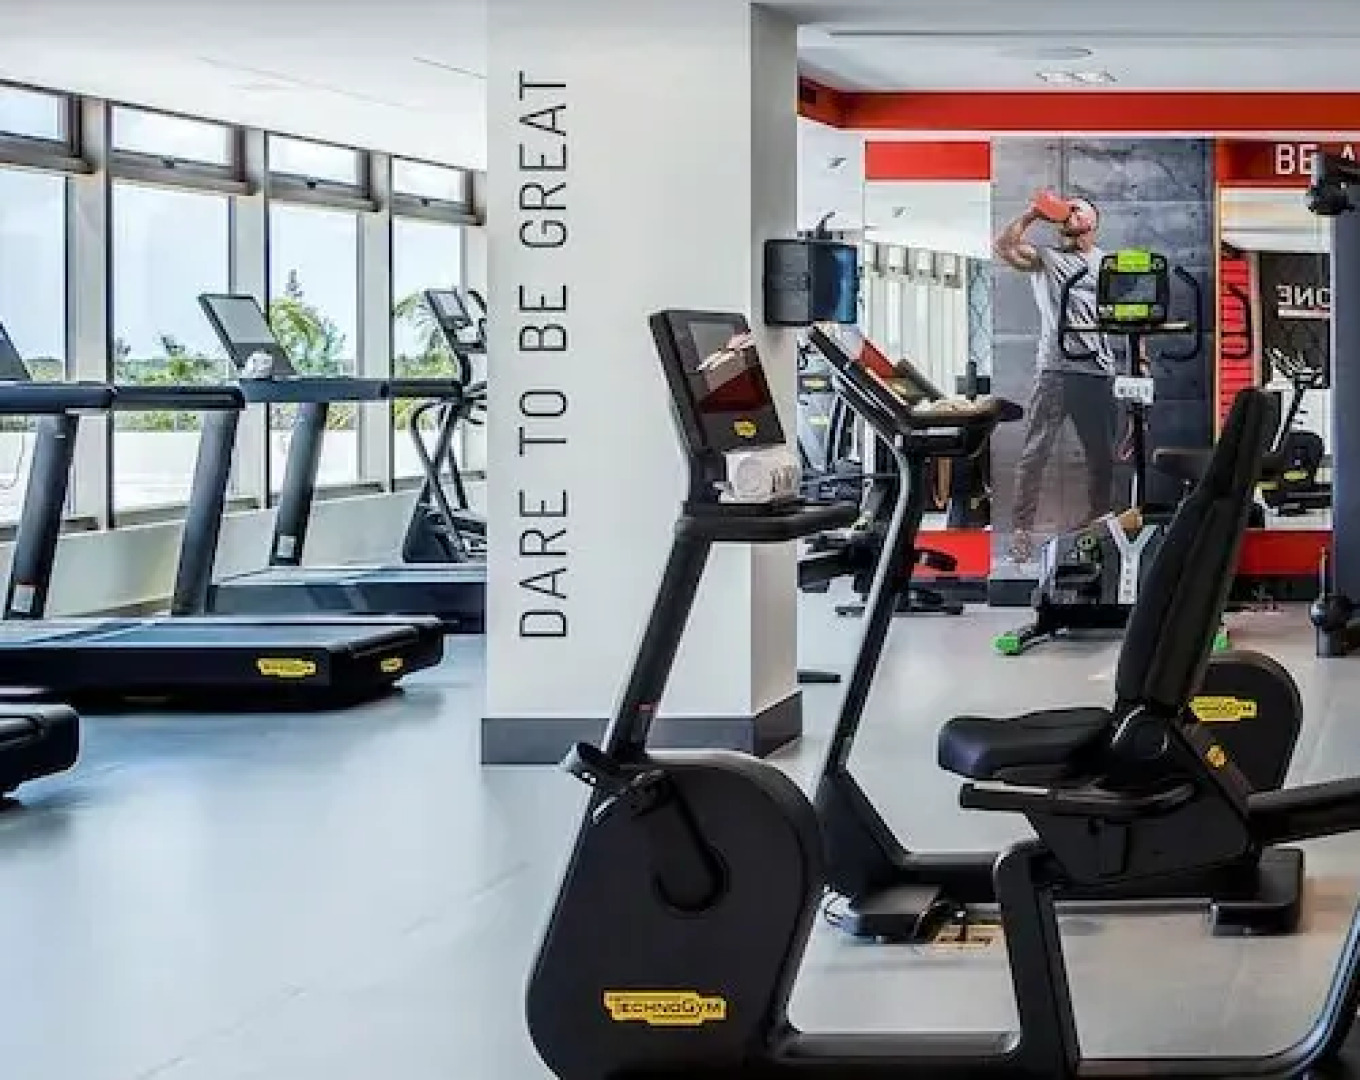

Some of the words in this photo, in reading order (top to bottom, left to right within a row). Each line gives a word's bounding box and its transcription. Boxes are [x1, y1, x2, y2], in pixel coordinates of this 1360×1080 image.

[518, 70, 567, 247] GREAT
[1275, 143, 1318, 175] BE
[518, 285, 567, 351] BE
[518, 391, 567, 455] TO
[518, 490, 567, 638] DARE
